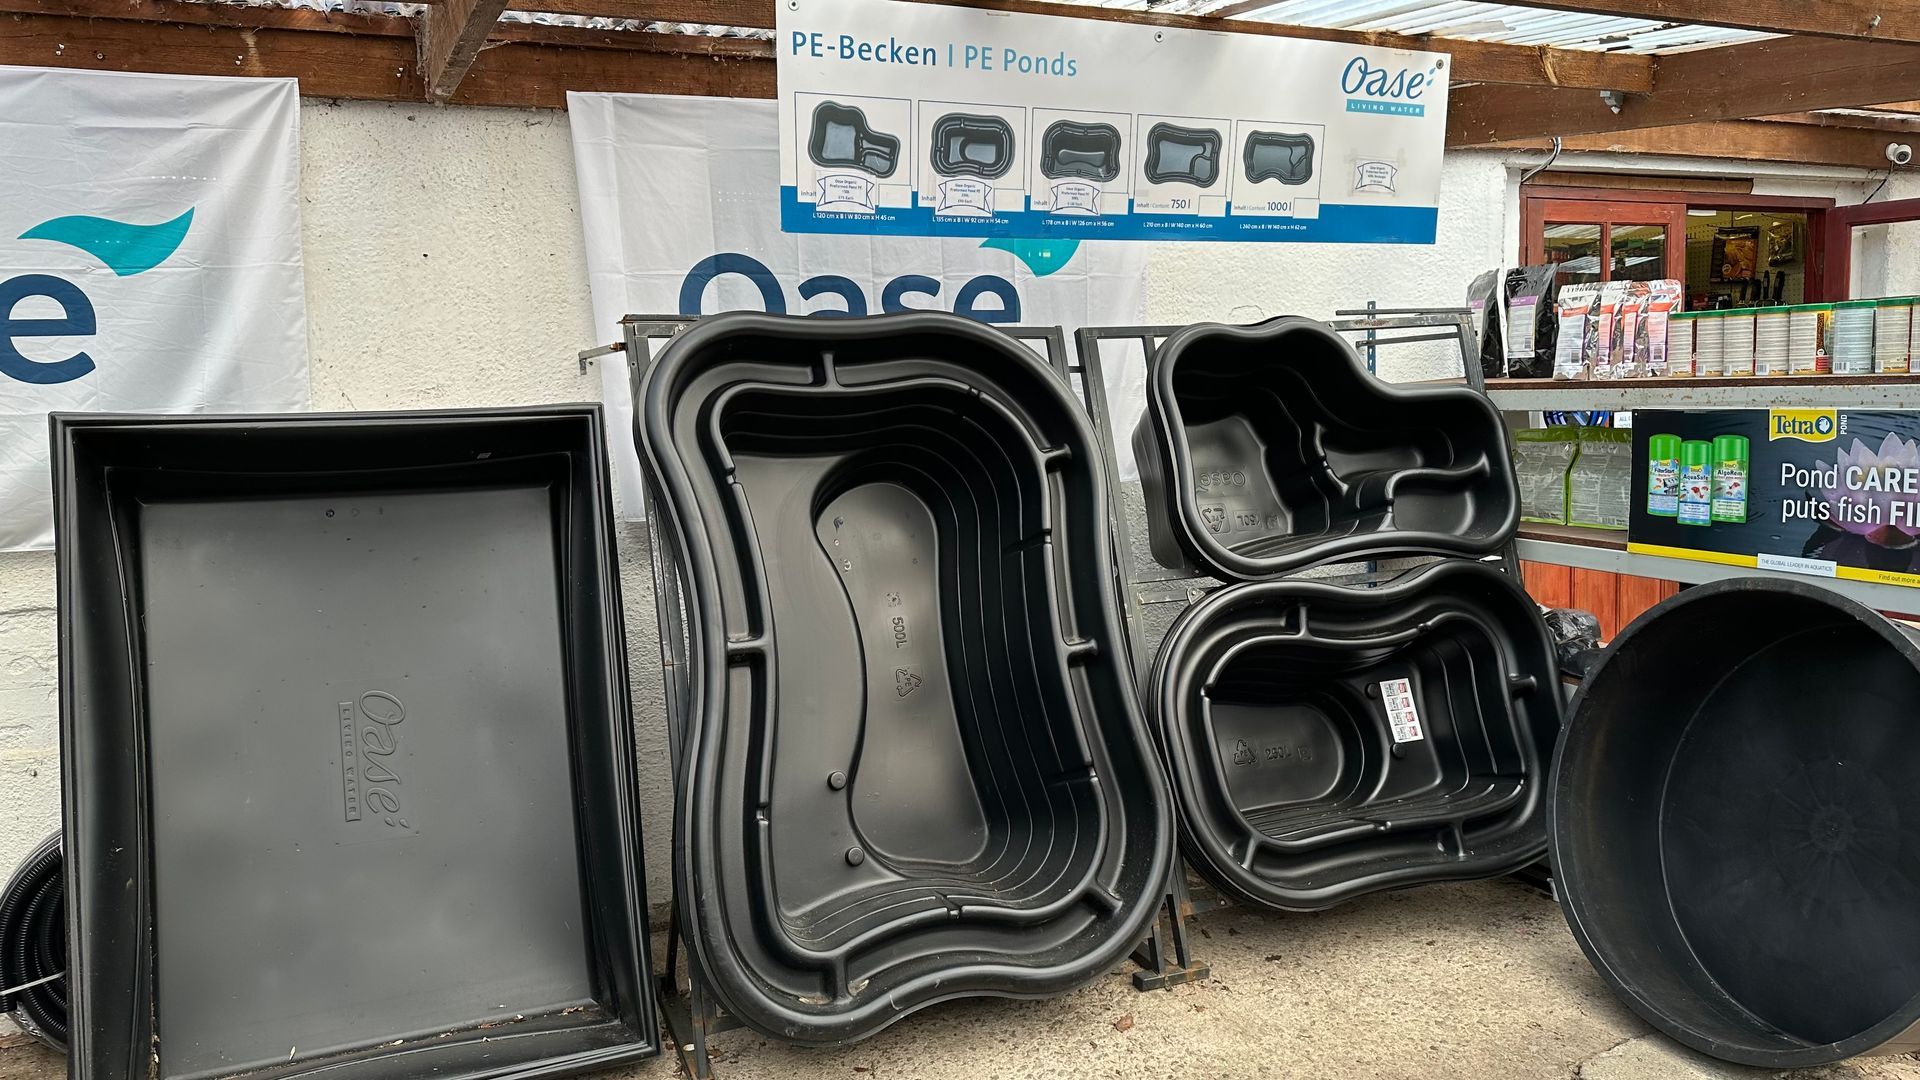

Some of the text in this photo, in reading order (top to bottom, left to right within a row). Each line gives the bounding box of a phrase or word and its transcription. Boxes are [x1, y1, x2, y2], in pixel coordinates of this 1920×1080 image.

[792, 31, 936, 66] PE-Becken
[965, 45, 993, 70] PE
[1003, 48, 1077, 77] Ponds
[1342, 56, 1424, 99] Oase
[1171, 199, 1186, 209] 750
[1268, 202, 1288, 211] 1000
[1772, 416, 1814, 434] Tetra
[1781, 463, 1919, 494] Pond CARE
[1782, 498, 1830, 523] puts
[1838, 496, 1880, 524] fish
[892, 617, 907, 648] 500L
[360, 690, 406, 813] Oase
